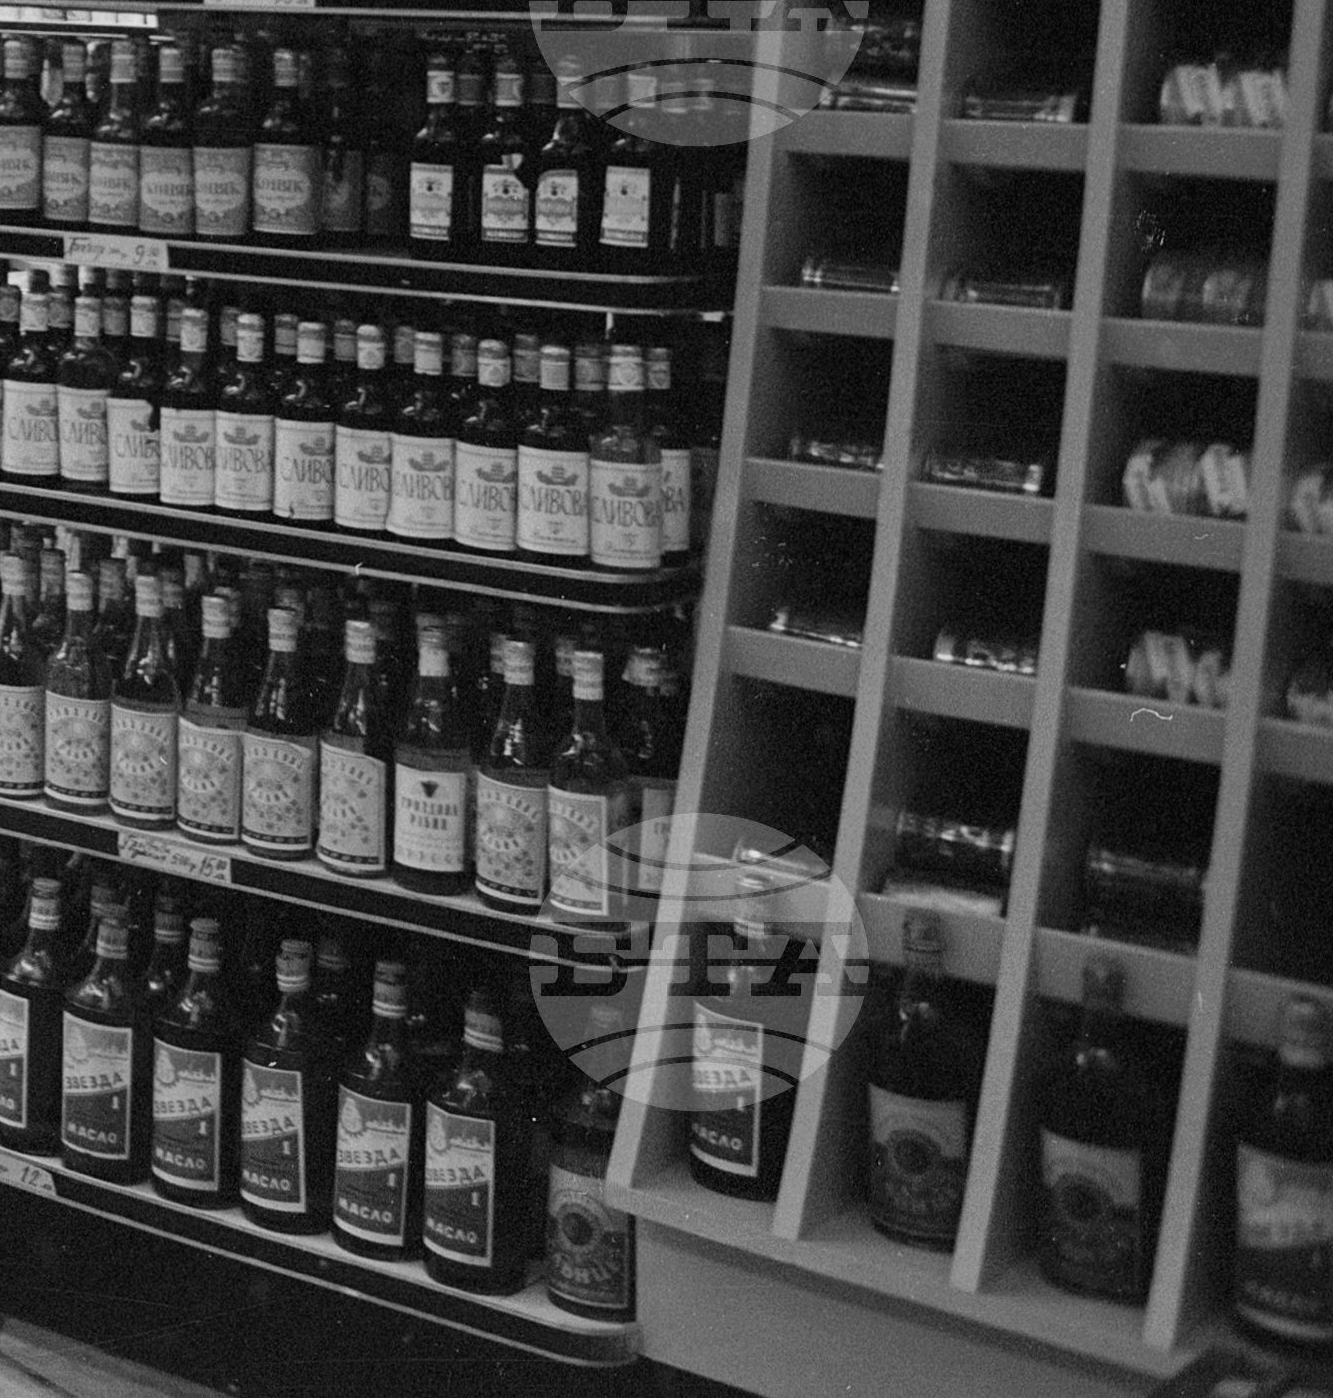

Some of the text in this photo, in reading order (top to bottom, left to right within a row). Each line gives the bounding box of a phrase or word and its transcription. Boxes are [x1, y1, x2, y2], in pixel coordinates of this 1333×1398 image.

[65, 1072, 123, 1090] ЗВЕЗДА
[154, 1096, 213, 1115] ЗВЕЗДА
[68, 1122, 118, 1144] МАСЛО
[155, 1147, 206, 1170] МАСЛО
[337, 1147, 402, 1165] ЗВЕЗДА
[339, 1197, 393, 1223] МАСЛО
[427, 1217, 478, 1244] МАСЛО
